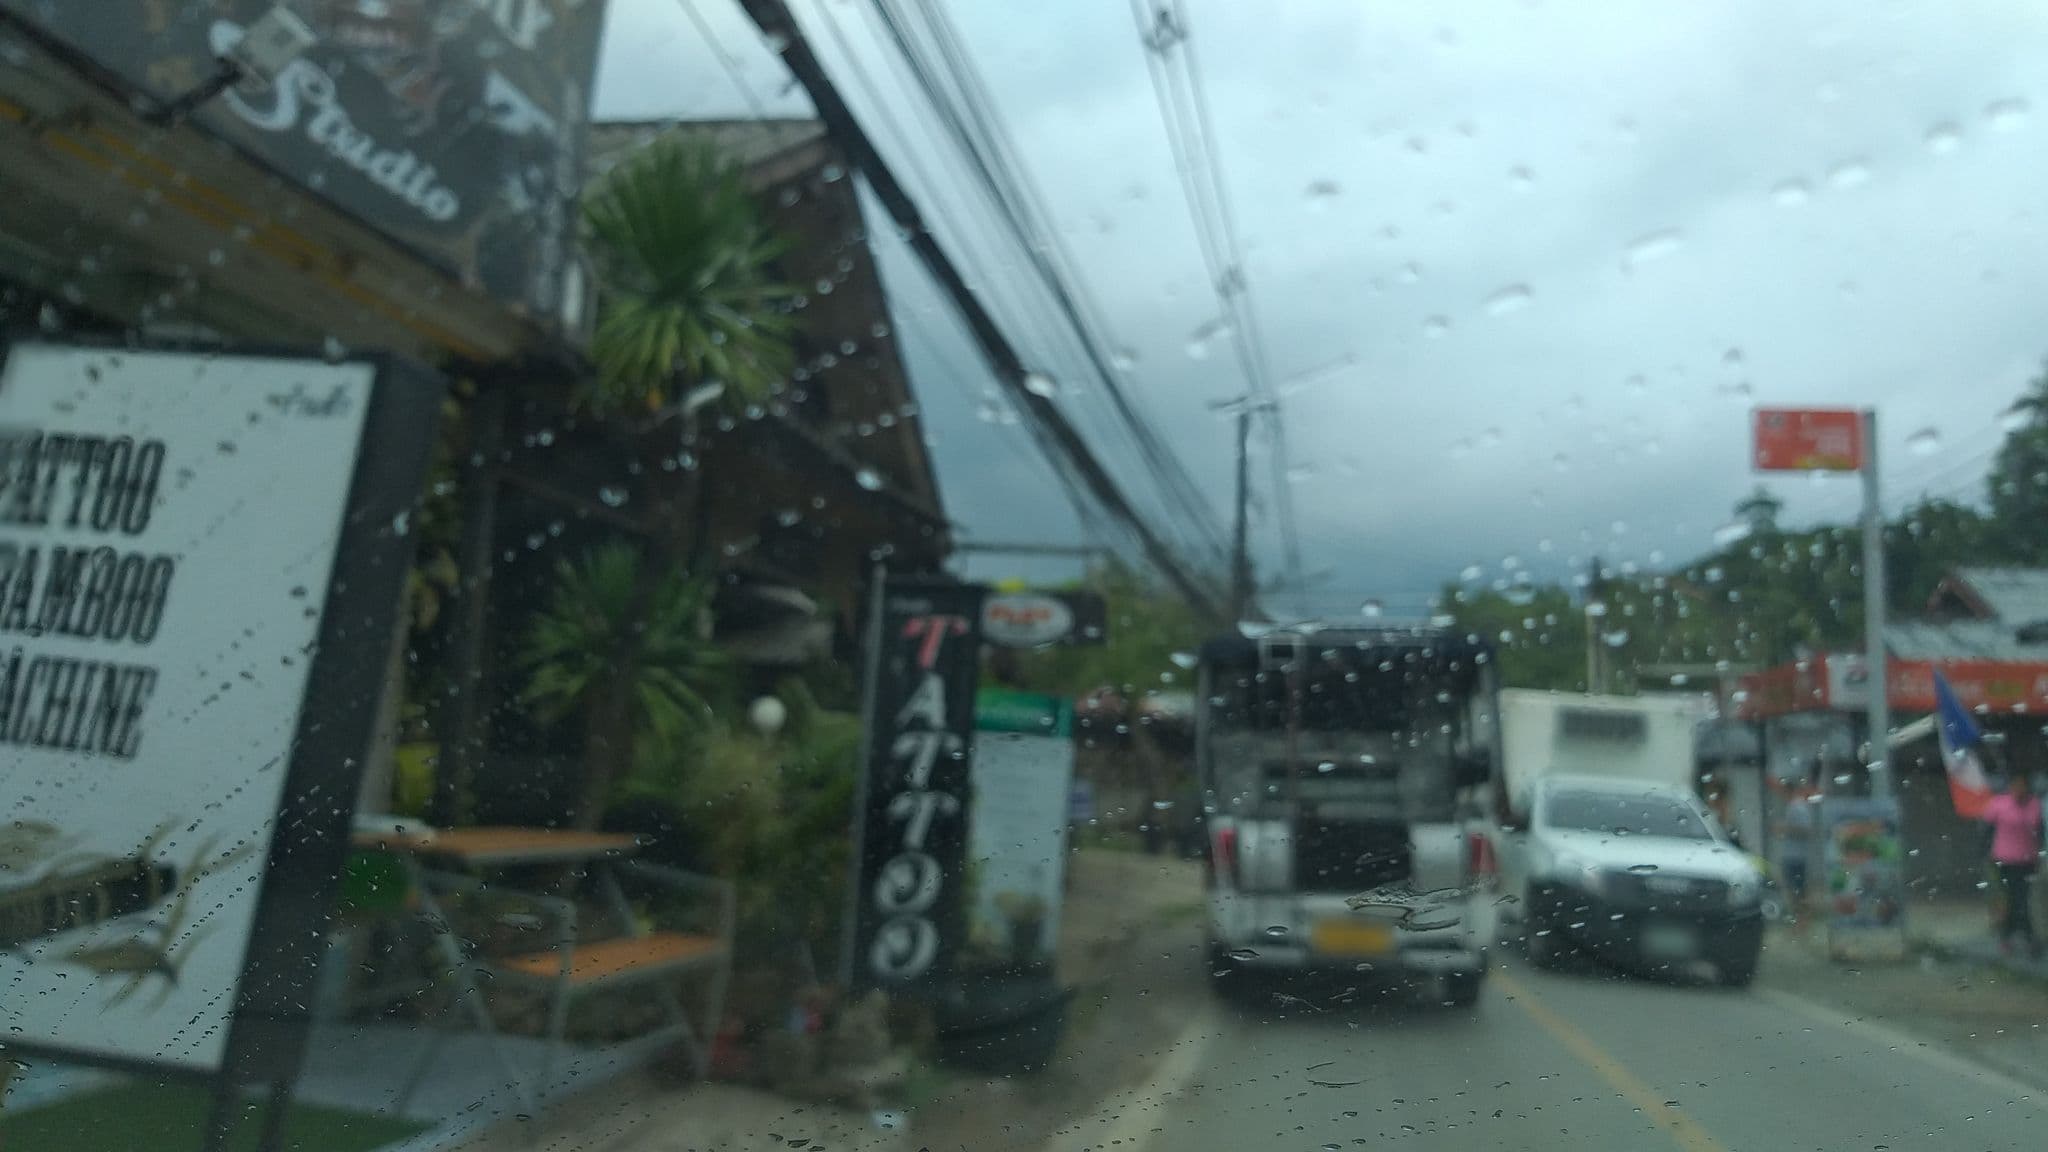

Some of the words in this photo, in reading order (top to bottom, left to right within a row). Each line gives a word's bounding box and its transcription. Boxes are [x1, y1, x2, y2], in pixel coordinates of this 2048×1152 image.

[222, 57, 460, 221] Studio
[0, 648, 159, 759] ACHINE
[869, 614, 969, 979] TATTOO
